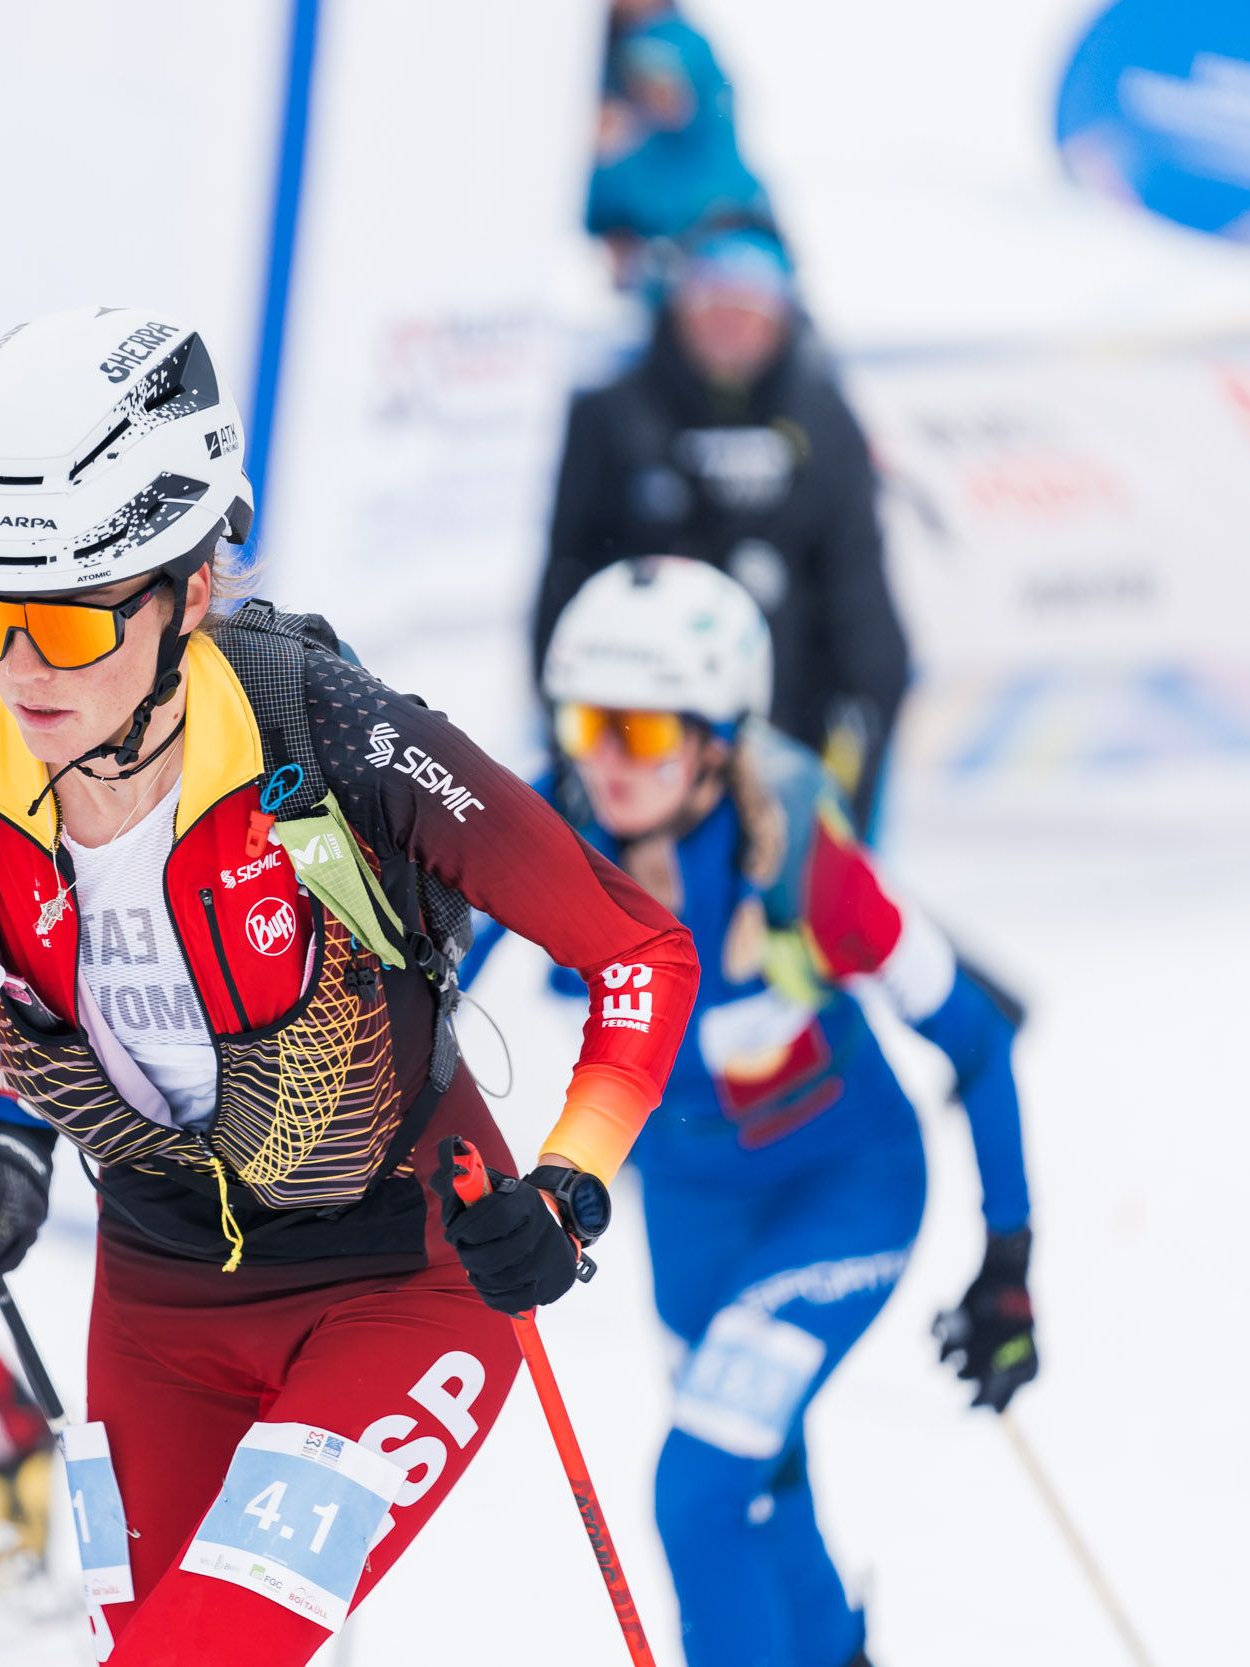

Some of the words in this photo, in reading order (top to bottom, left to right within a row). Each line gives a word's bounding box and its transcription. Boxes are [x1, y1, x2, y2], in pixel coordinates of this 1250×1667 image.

[99, 320, 180, 384] SHERPA
[220, 422, 238, 447] ATK
[76, 569, 112, 584] ATOMIC
[392, 745, 485, 823] SISMIC
[327, 832, 343, 859] MILLET
[237, 850, 282, 884] SISMIC
[601, 1019, 650, 1033] FEDME
[358, 1350, 487, 1555] SP
[243, 1480, 340, 1554] 4.1
[264, 1574, 284, 1590] FGC
